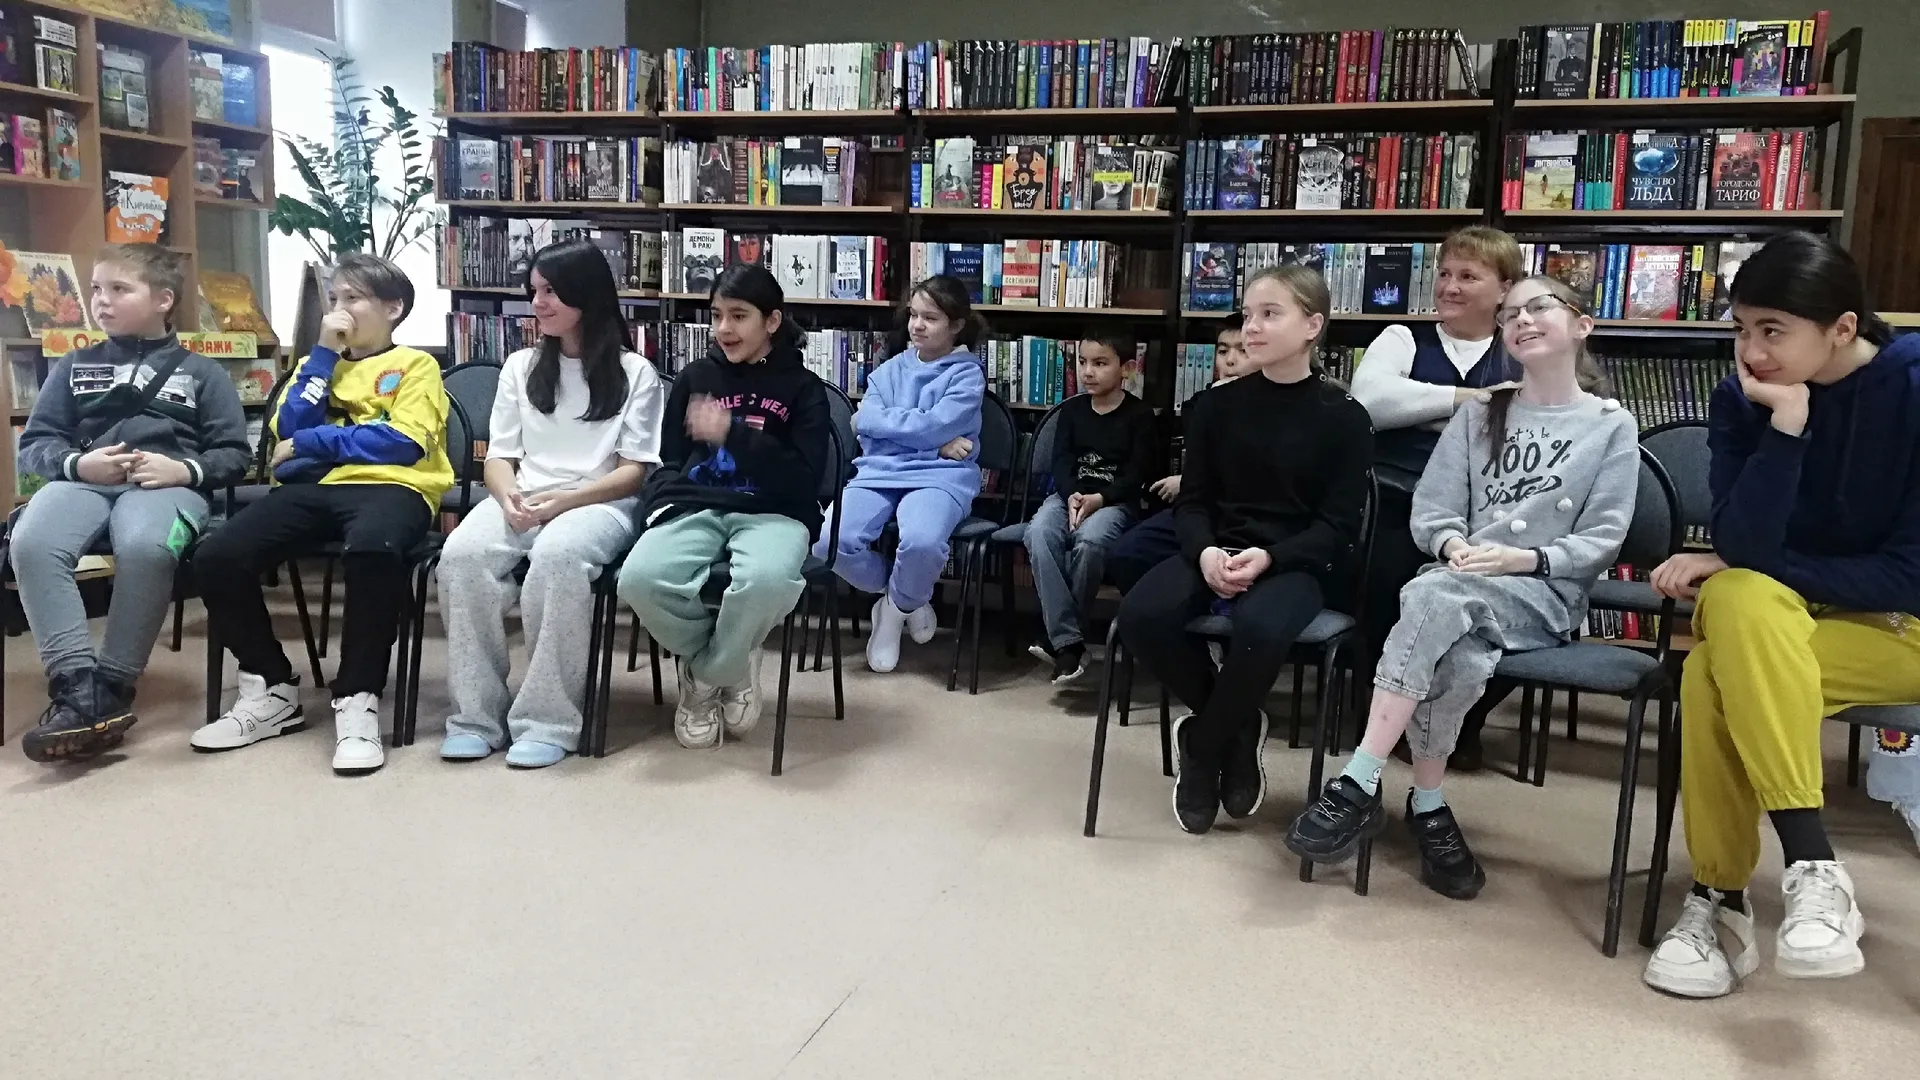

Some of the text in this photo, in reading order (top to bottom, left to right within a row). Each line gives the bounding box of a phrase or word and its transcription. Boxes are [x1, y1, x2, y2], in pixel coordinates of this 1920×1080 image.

[1632, 177, 1676, 186] ЧУВСТВО
[1716, 179, 1761, 188] ГОРОДСКОЙ
[1630, 187, 1674, 203] ЛЬДА
[1716, 189, 1761, 201] ТАРИФ
[180, 340, 232, 354] ЕЙЗАЖИ
[1504, 427, 1550, 444] Let's be
